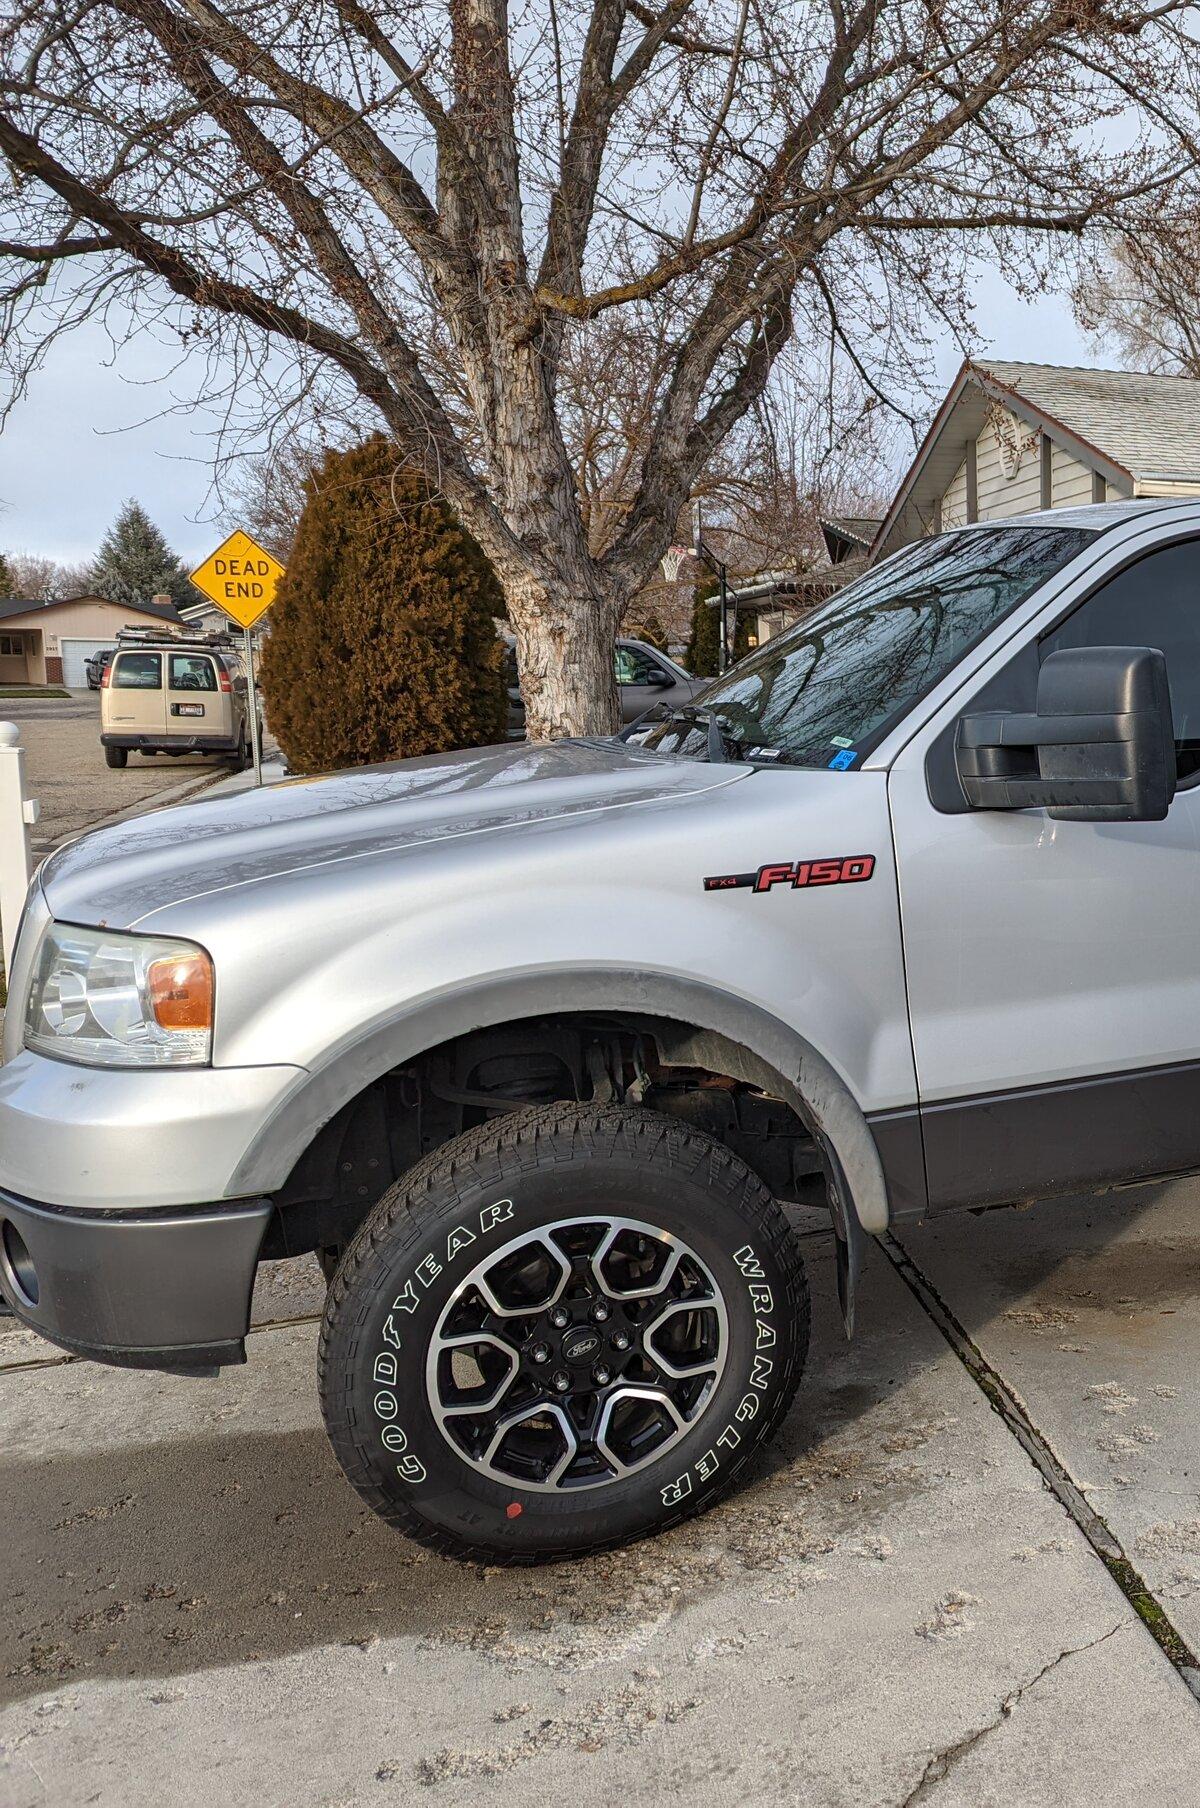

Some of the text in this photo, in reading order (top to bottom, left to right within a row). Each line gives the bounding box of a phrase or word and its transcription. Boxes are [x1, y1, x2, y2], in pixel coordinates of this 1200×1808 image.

[214, 559, 270, 576] DEAD
[224, 581, 264, 598] END
[708, 855, 875, 891] FX4 F-150
[373, 1199, 516, 1483] GOODYEAR
[659, 1244, 777, 1507] WRANGLER
